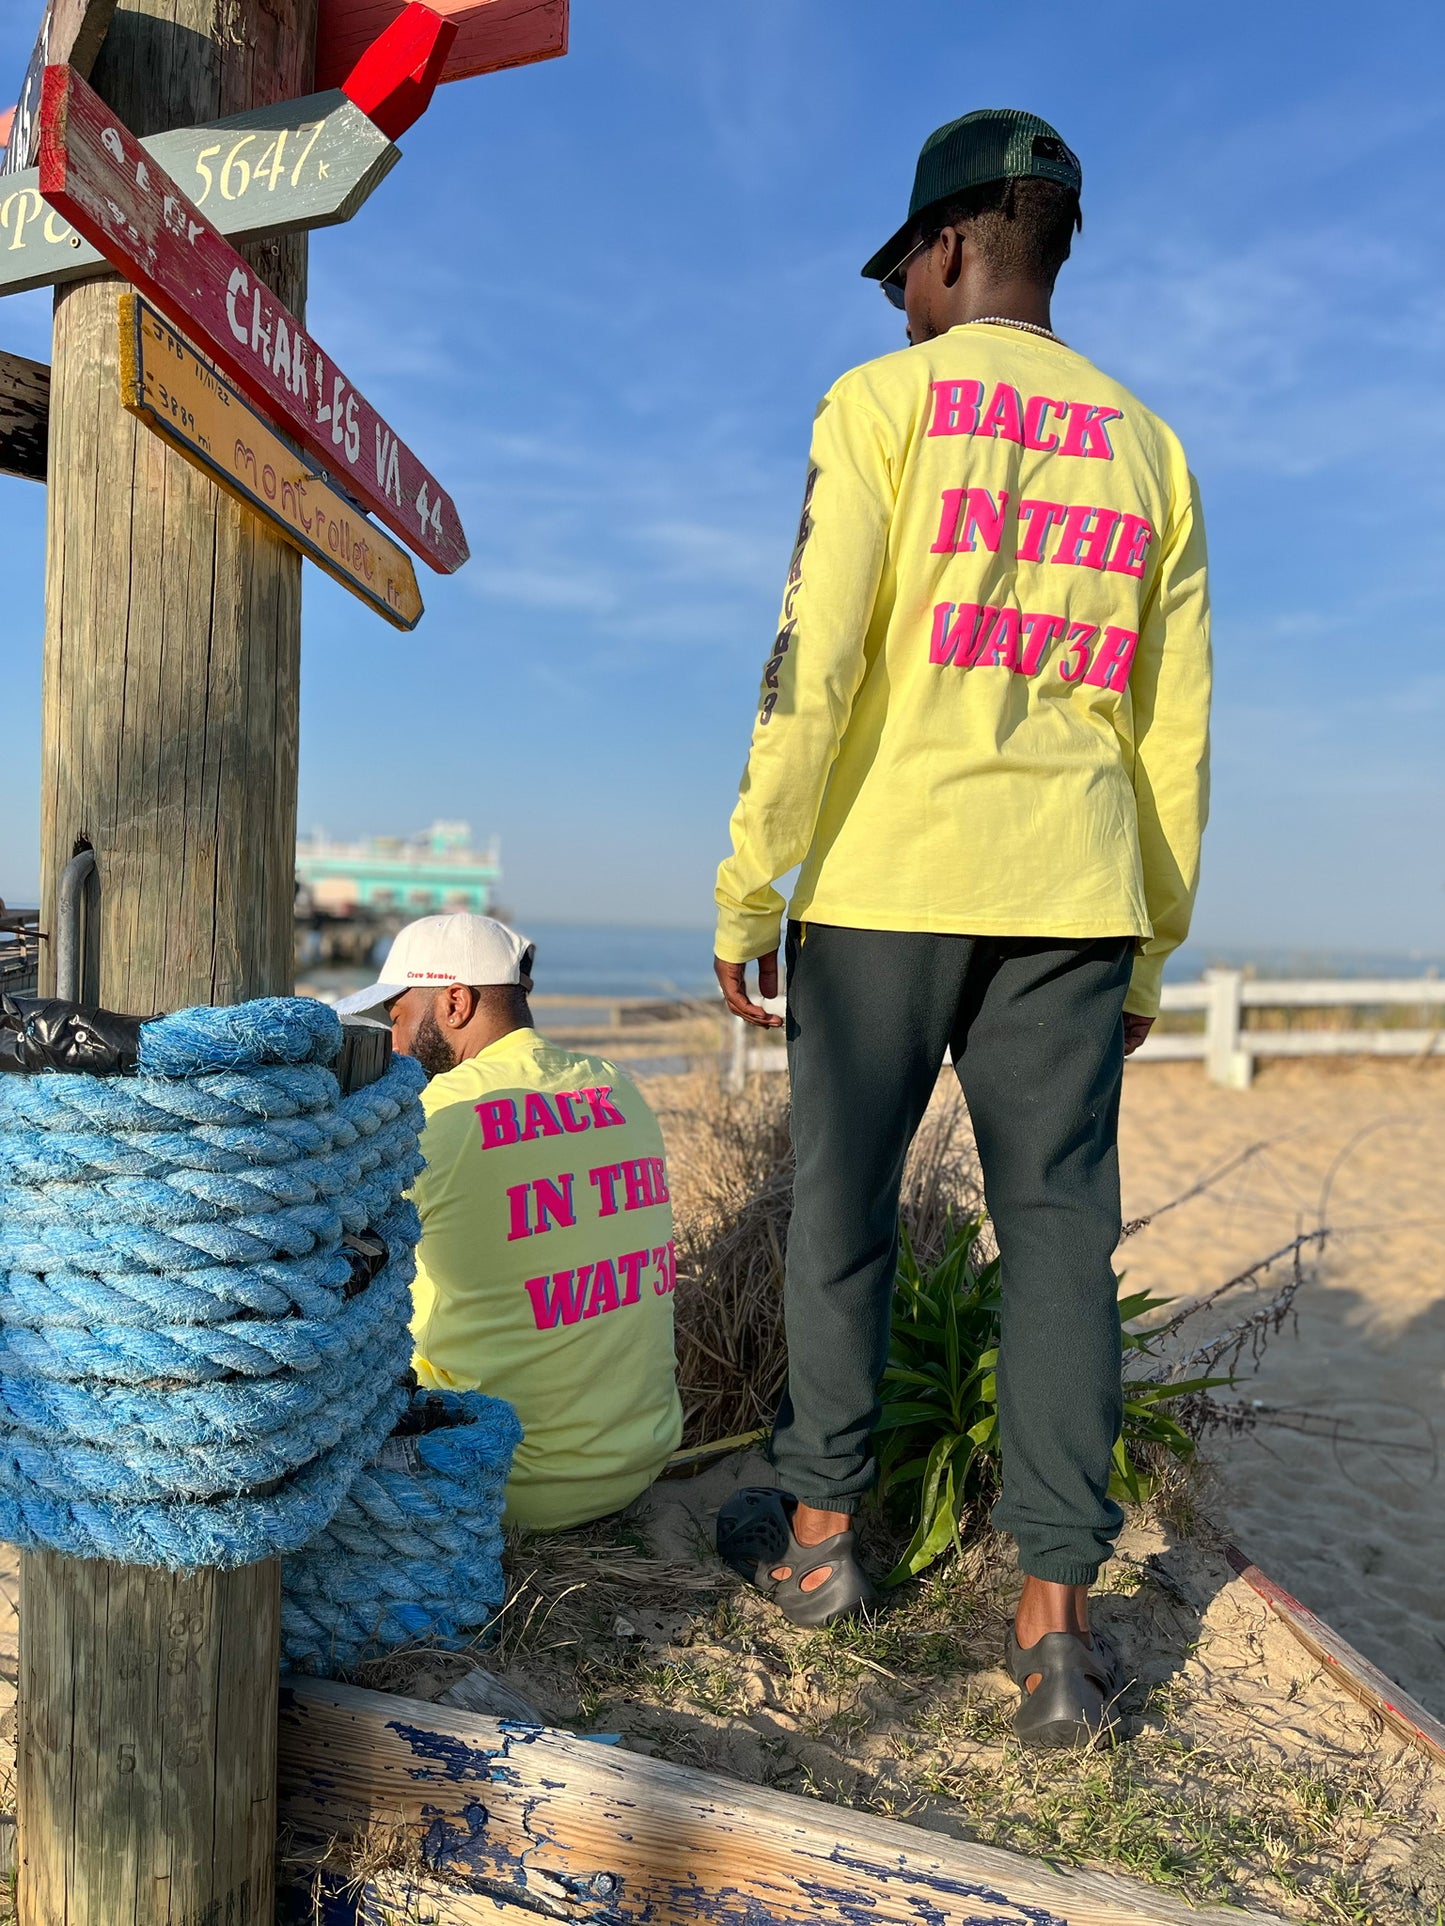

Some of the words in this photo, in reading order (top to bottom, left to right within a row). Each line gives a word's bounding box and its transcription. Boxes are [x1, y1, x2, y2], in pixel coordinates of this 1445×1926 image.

[194, 119, 325, 207] 5647
[152, 322, 184, 360] JPB
[927, 379, 1123, 461] BACK
[929, 487, 1009, 554] IN
[1014, 499, 1152, 580] THE
[474, 1085, 626, 1150] BACK
[506, 1173, 577, 1242] IN
[589, 1157, 670, 1218] THE
